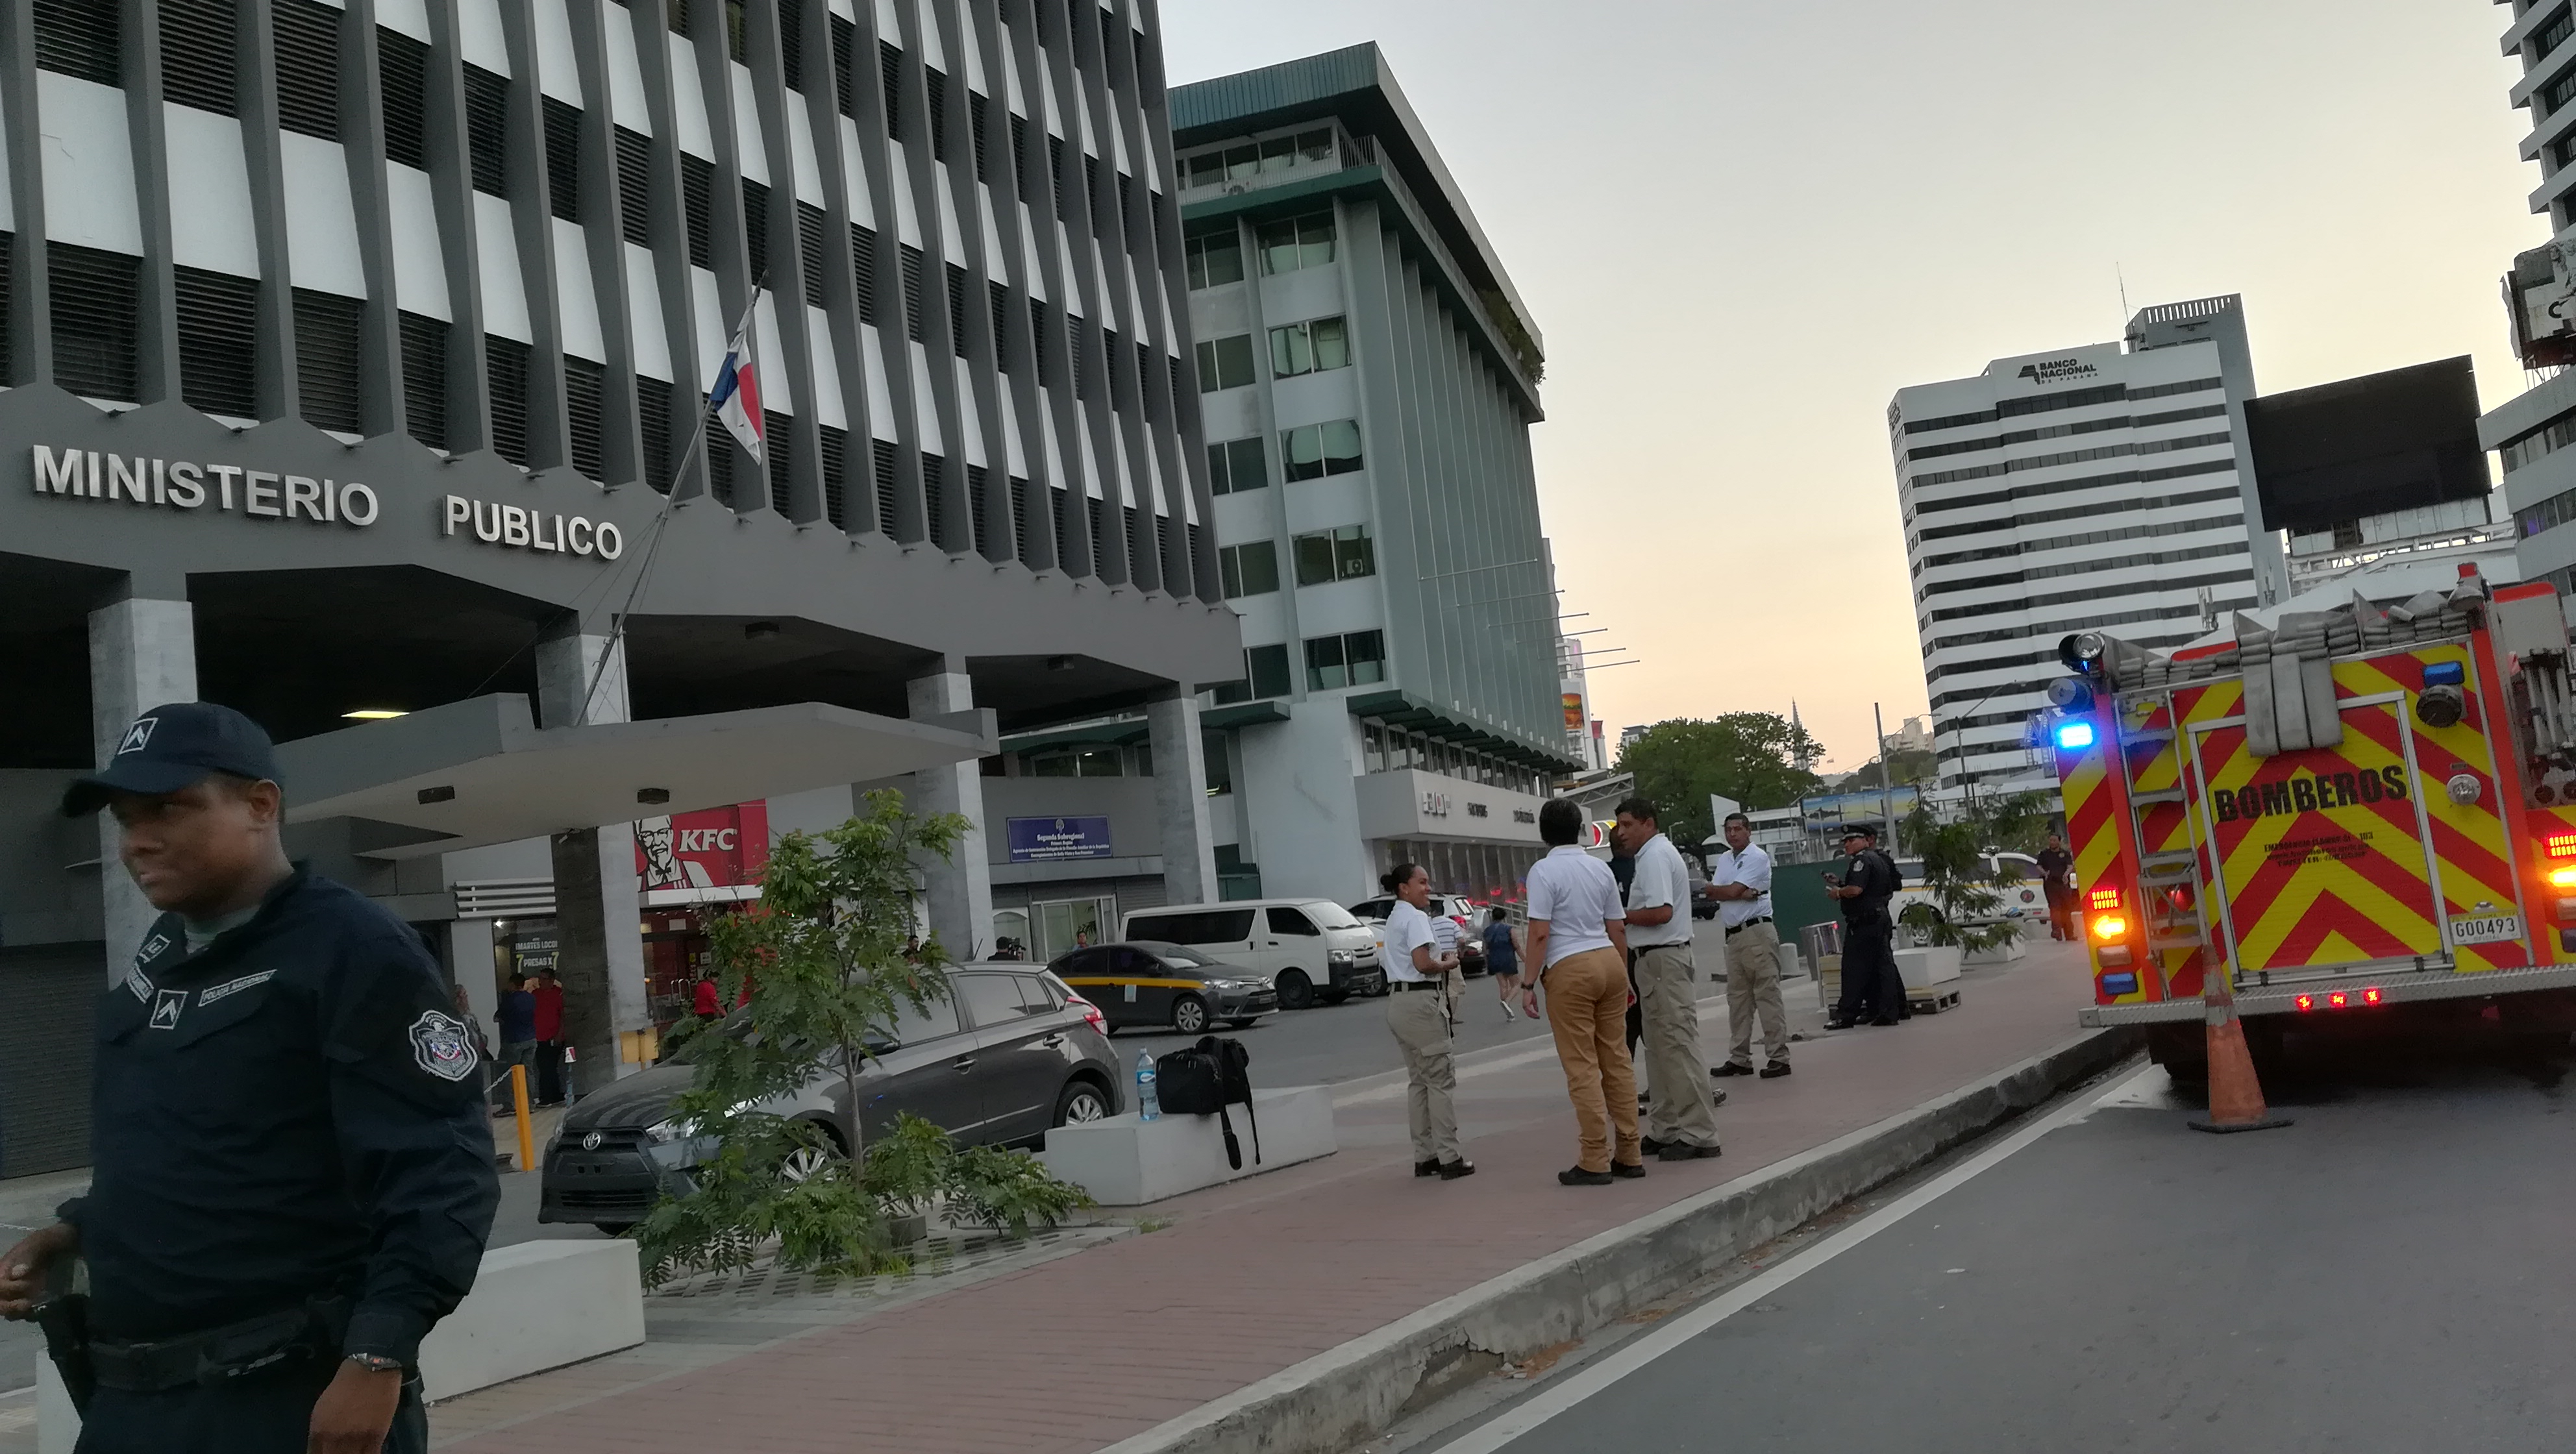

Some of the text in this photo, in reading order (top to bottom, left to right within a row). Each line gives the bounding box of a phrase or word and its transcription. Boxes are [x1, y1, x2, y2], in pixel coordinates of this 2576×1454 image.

[2039, 358, 2077, 371] BANCO
[2040, 364, 2097, 378] NACIONAL
[2060, 373, 2098, 381] PANAMA
[32, 445, 623, 560] MINISTERIO PUBLICO
[2214, 765, 2407, 822] BOMBEROS
[678, 828, 735, 852] KFC
[2359, 831, 2373, 841] 103
[2455, 917, 2516, 937] G00493
[516, 954, 524, 974] 7
[523, 957, 547, 967] PRESAS
[551, 951, 560, 971] 7
